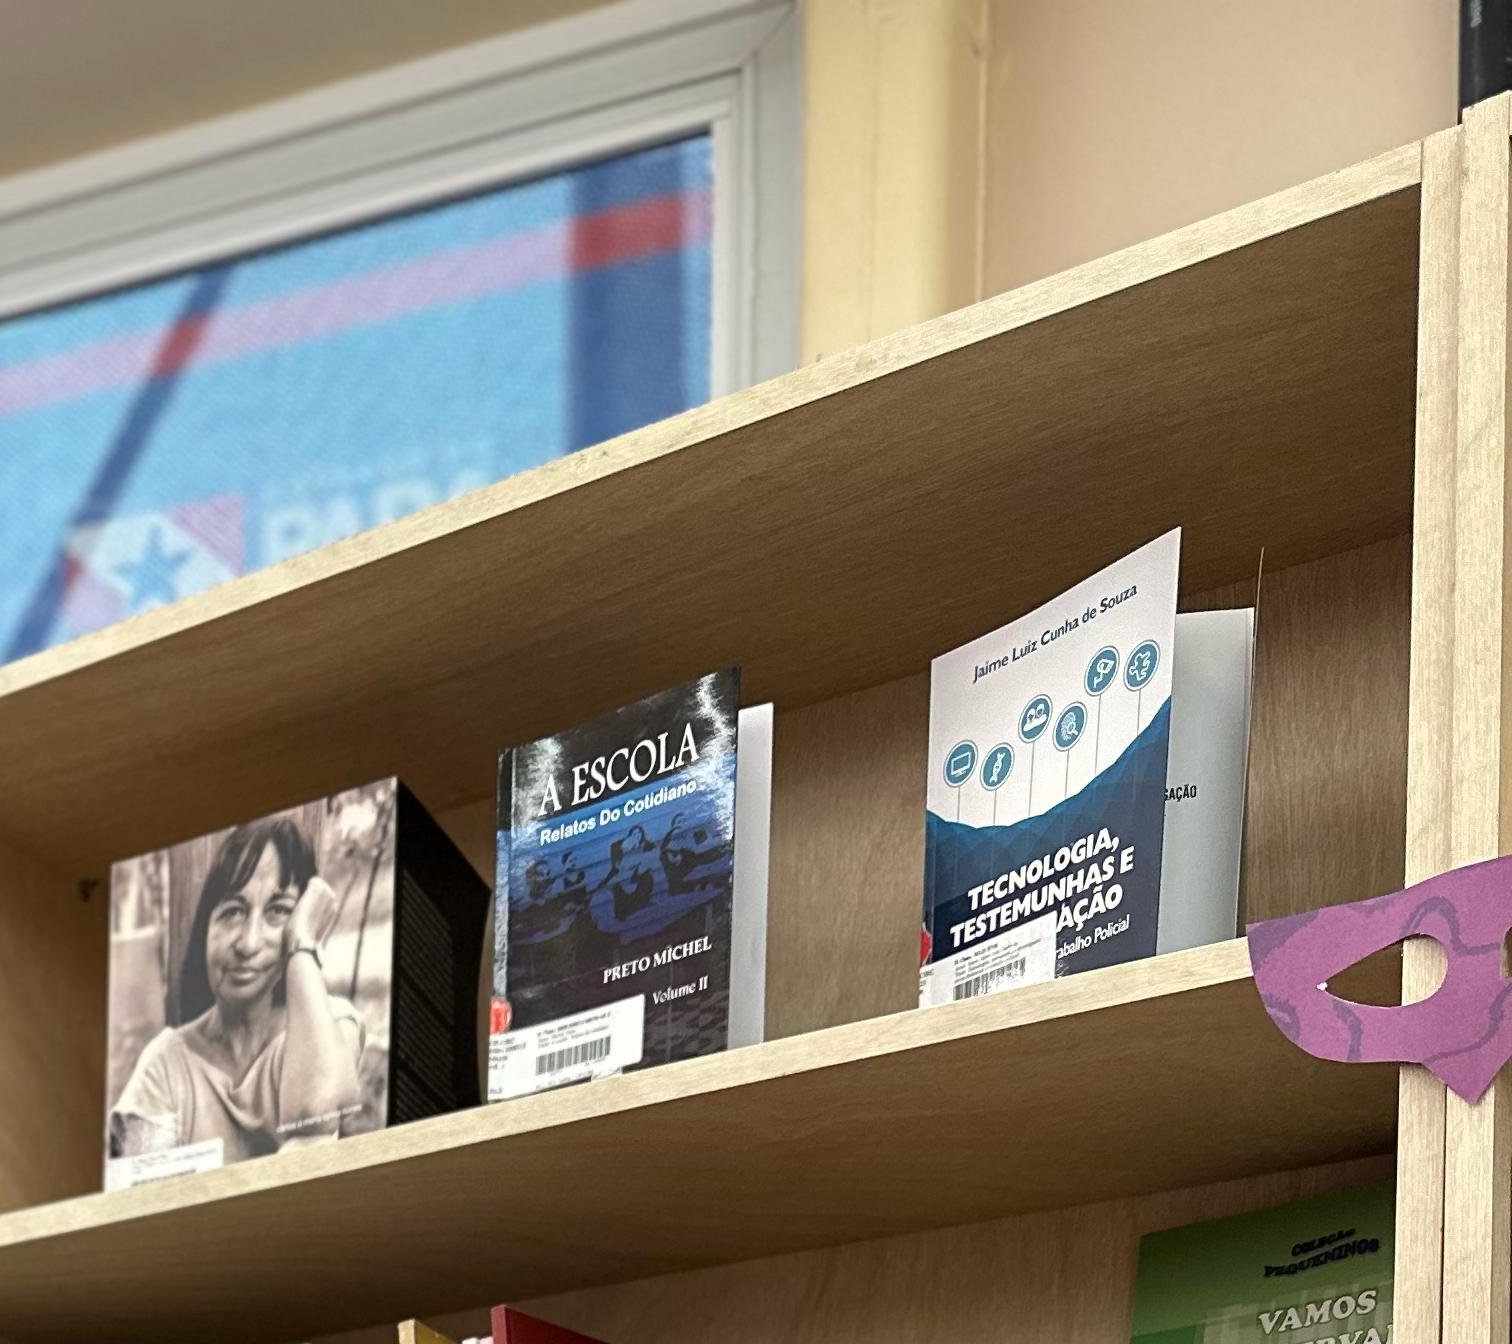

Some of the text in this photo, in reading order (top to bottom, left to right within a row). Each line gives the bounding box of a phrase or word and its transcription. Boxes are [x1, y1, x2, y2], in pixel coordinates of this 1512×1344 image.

[972, 582, 1138, 683] Jaime Luiz Cunha de Souza
[537, 722, 700, 817] A ESCOLA
[540, 779, 697, 846] Relatos Do Cotidiano
[967, 827, 1121, 911] TECNOLOGIA,
[949, 845, 1135, 948] TESTEMUNHAS E
[1054, 883, 1123, 934] AÇÃO
[603, 935, 712, 984] PRETO MICHEL
[1055, 914, 1130, 961] rabalho Policial
[652, 975, 708, 1005] Volume II
[1264, 1237, 1380, 1278] PEQUENINOS
[1257, 1290, 1378, 1336] VAMOS
